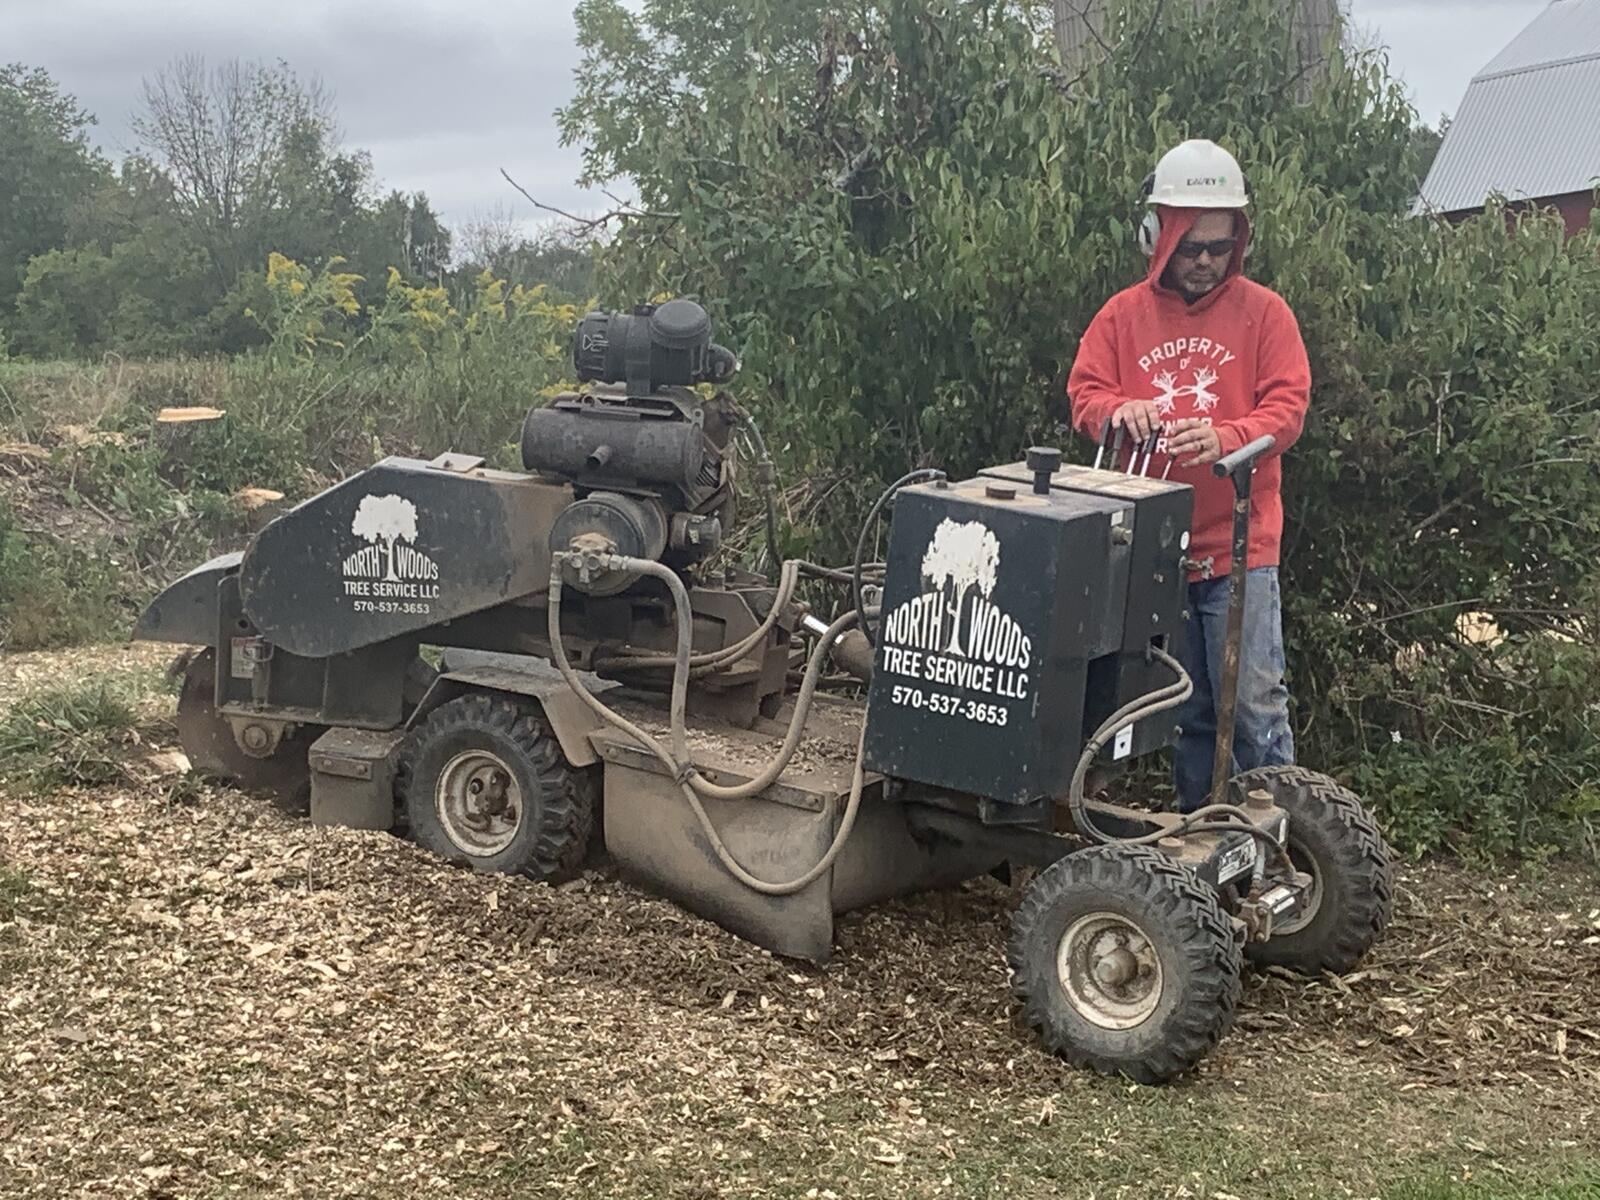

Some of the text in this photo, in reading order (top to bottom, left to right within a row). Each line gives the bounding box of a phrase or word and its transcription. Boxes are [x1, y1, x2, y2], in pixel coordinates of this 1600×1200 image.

[1138, 337, 1235, 372] PROPERTY
[343, 545, 439, 580] NORTH WOODS
[343, 581, 440, 599] TREE SERVICE LLC
[353, 601, 430, 614] 570-537-3653
[884, 591, 1031, 669] NORTH WOODS
[883, 646, 1029, 699] TREE SERVICE LLC
[891, 685, 1008, 726] 570-537-3653
